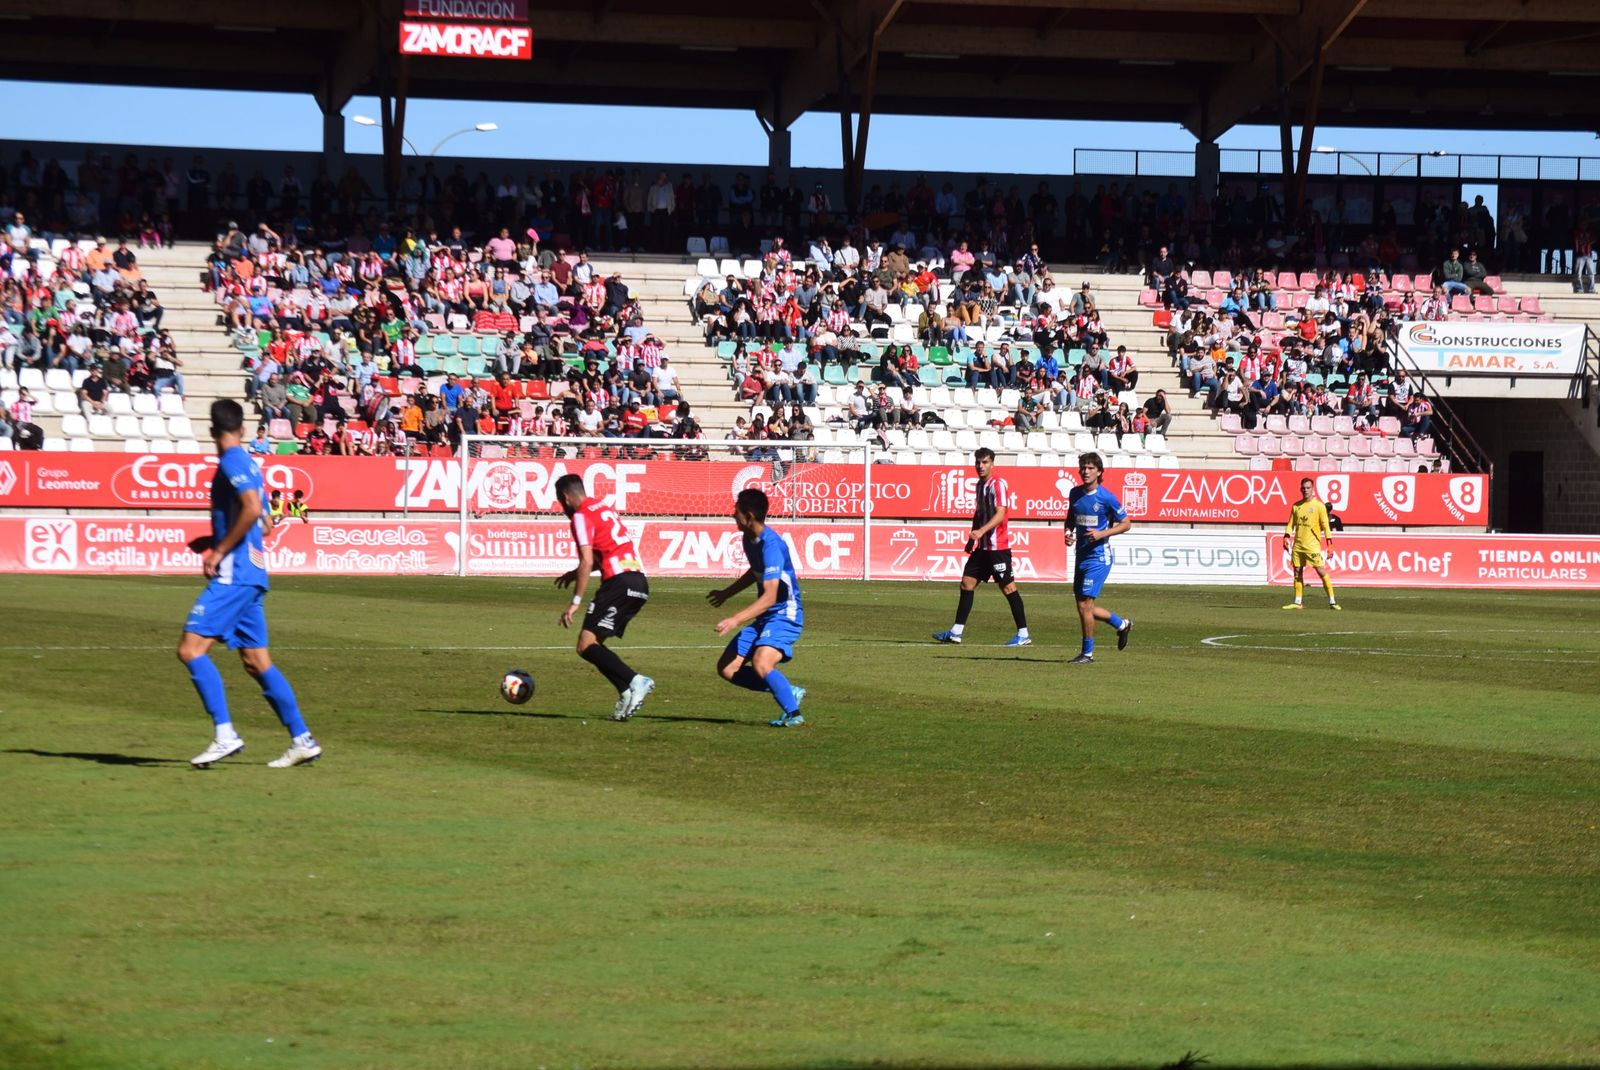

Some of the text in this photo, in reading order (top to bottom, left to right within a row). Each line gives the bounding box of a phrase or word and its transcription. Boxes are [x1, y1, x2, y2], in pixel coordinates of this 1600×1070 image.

[1409, 323, 1562, 348] CONSTRUCCIONES
[1532, 360, 1560, 370] S.A.
[36, 467, 69, 478] Grupo
[37, 479, 101, 491] Leomotor
[835, 477, 911, 499] ÓPTICO
[1160, 473, 1288, 505] ZAMORA
[1327, 479, 1342, 504] 8
[1393, 479, 1408, 506] 8
[1460, 481, 1475, 507] 8
[782, 498, 875, 514] ROBERTO
[1159, 508, 1240, 519] AYUNTAMIENTO
[1373, 491, 1399, 522] ZAMORA
[1440, 492, 1466, 523] ZAMORA
[84, 522, 186, 544] Carné Joven
[313, 525, 428, 546] Escuela
[487, 529, 571, 540] bodegas del
[84, 546, 147, 567] Castilla
[149, 552, 159, 570] y
[316, 549, 428, 571] infantil
[1162, 547, 1260, 568] STUDIO
[1397, 551, 1452, 578] Chef
[1478, 550, 1544, 563] TIENDA
[1478, 567, 1588, 580] PARTICULARES
